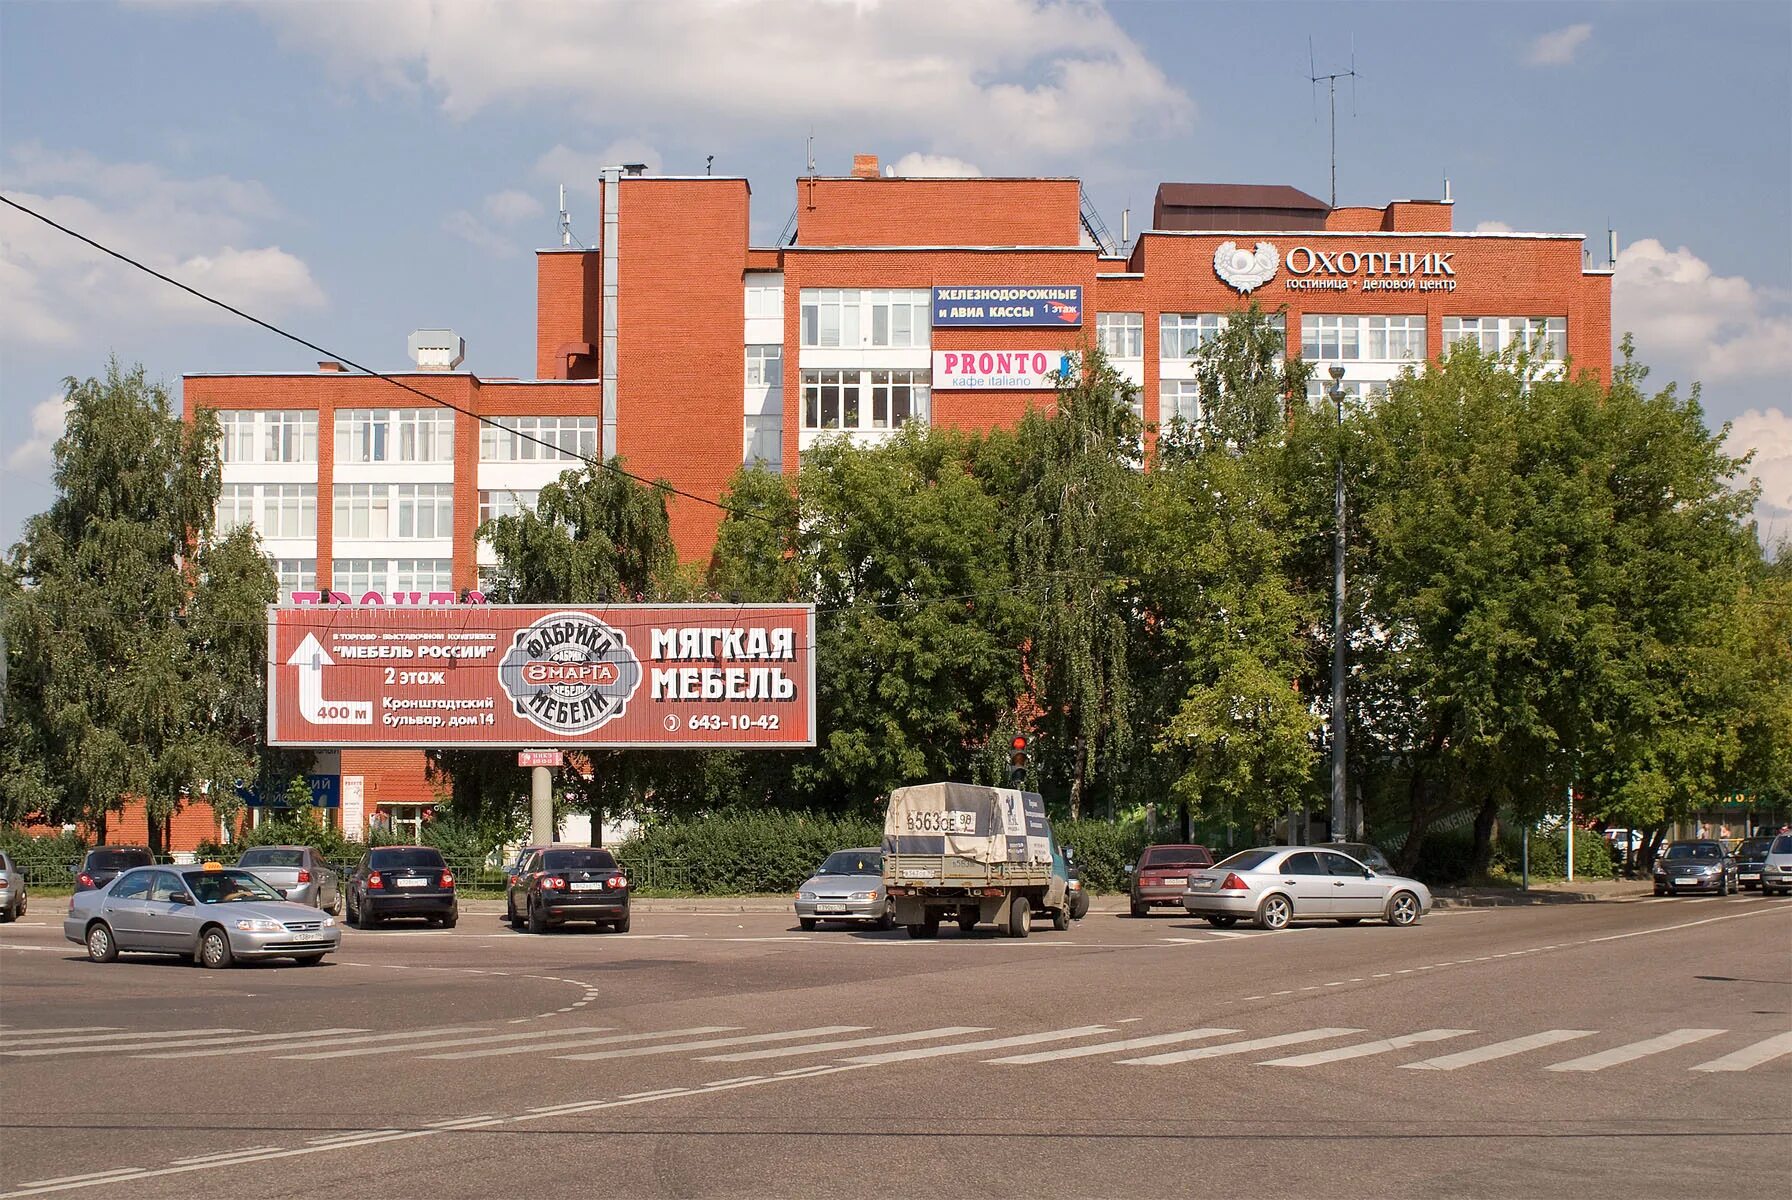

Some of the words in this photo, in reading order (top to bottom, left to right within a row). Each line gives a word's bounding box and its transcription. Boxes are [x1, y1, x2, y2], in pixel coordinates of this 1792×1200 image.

[1286, 278, 1348, 290] гостиница
[1362, 277, 1415, 290] деловой
[1419, 280, 1456, 292] центр
[938, 289, 1077, 301] ЖЕЛЕЗНОДОРОЖНЫЕ
[950, 307, 984, 318] АВИА
[989, 307, 1034, 318] КАССЫ
[1043, 304, 1049, 313] 1
[1051, 305, 1077, 314] этаж
[944, 353, 1047, 375] PRONTO
[953, 376, 985, 388] кафе
[988, 376, 1031, 387] italiano
[527, 622, 612, 660] ФАБРИКА
[651, 628, 794, 660] МЯГКАЯ
[384, 667, 396, 685] 2
[400, 671, 445, 685] этаж
[651, 667, 795, 700] МЕБЕЛЬ
[382, 697, 494, 711] Кронштадтский
[528, 688, 609, 724] МЕБЕЛИ
[317, 706, 350, 719] 400
[448, 715, 477, 727] дом
[479, 713, 495, 725] 14
[688, 714, 780, 730] 643-10-42
